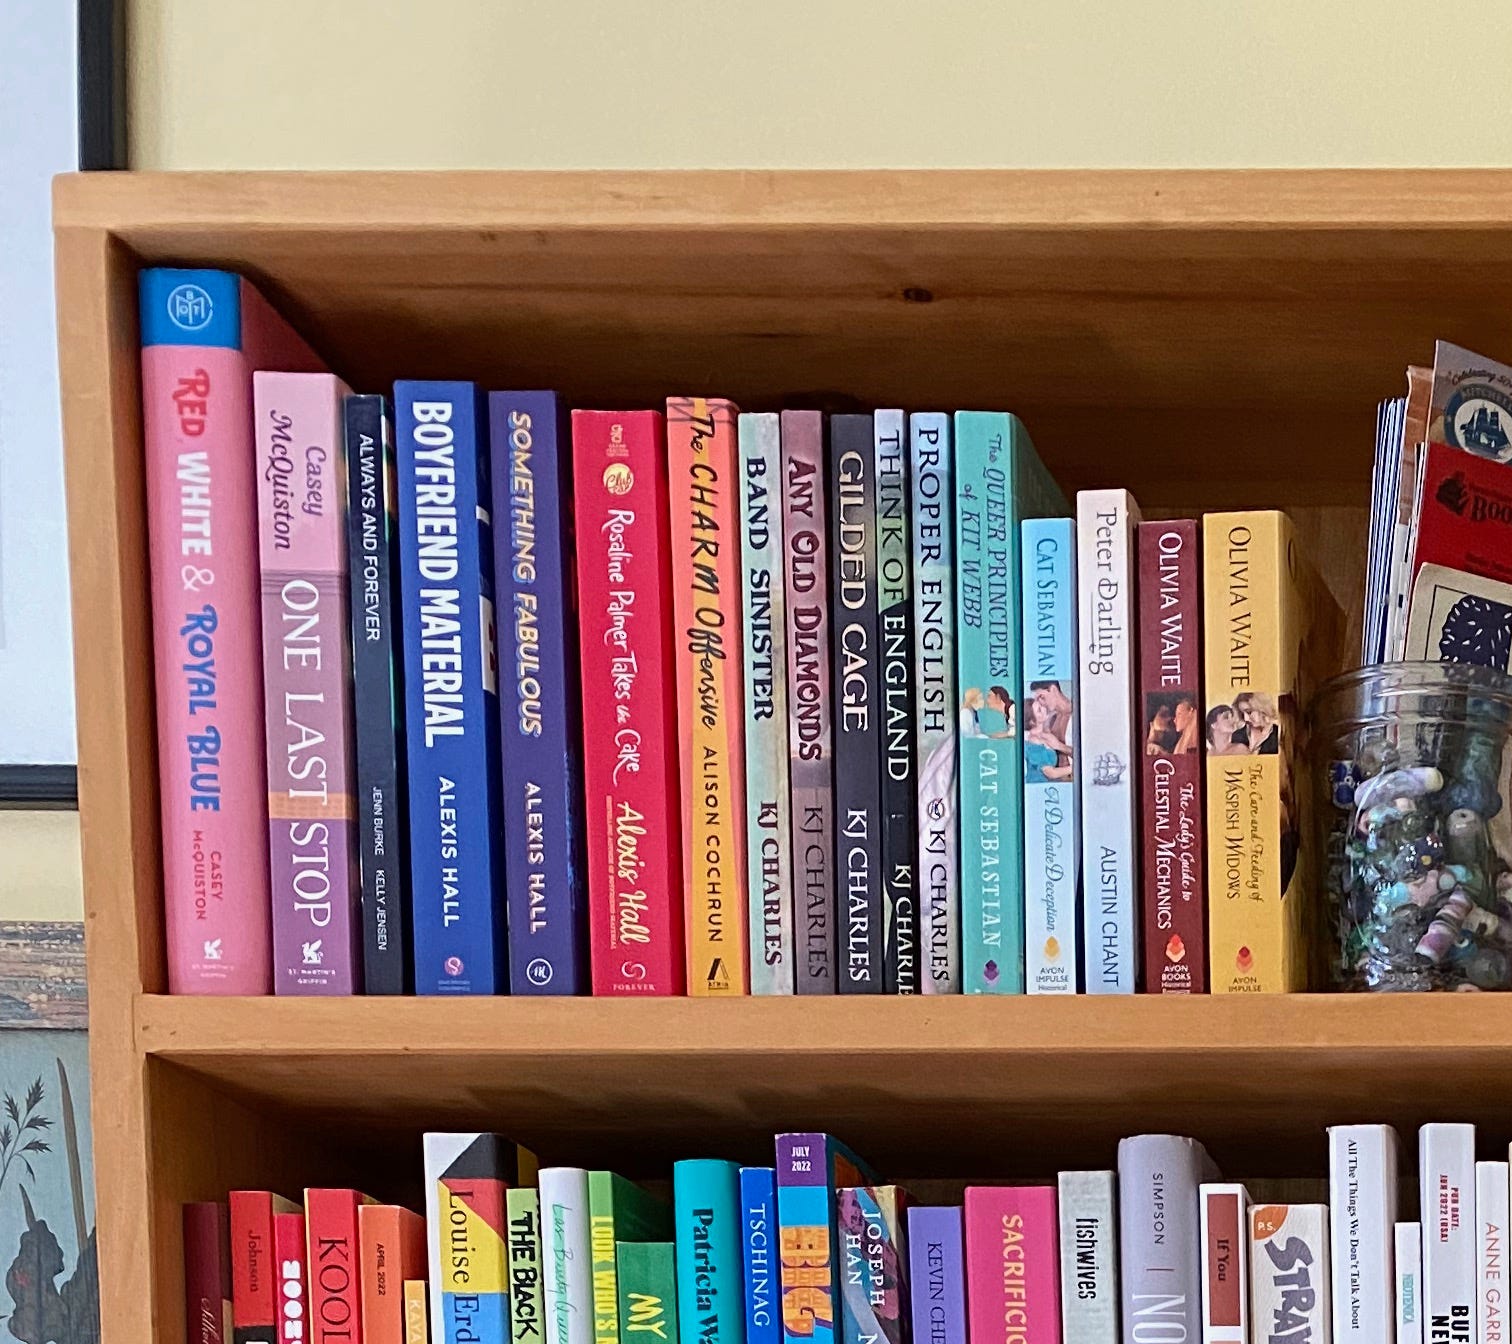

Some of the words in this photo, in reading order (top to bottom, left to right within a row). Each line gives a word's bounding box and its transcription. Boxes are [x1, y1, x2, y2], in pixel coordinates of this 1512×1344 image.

[176, 451, 212, 556] WHITE
[359, 434, 375, 517] ALWAYS
[413, 401, 459, 581] BOYFRIEND
[510, 412, 536, 581] SOMETHING
[746, 456, 768, 550] BAND
[363, 522, 376, 550] AND
[838, 450, 868, 609] GILDED
[1096, 506, 1119, 582] Peter
[1158, 532, 1180, 608] OLIVIA
[181, 565, 215, 592] &
[363, 555, 380, 641] FOREVER
[185, 604, 218, 715] ROYAL
[280, 579, 321, 670] ONE
[513, 590, 542, 737] FABULOUS
[749, 568, 774, 721] SINISTER
[1095, 576, 1120, 675] Darling
[1158, 615, 1182, 686] WAITE
[419, 589, 466, 747] MATERIAL
[841, 624, 868, 732] CAGE
[187, 726, 221, 812] BLUE
[285, 692, 325, 806] LAST
[704, 746, 720, 826] ALISON
[192, 830, 207, 920] McQUISTON
[210, 851, 222, 901] CASEY
[289, 822, 331, 927] STOP
[706, 833, 722, 942] COCHRUN
[1100, 846, 1116, 905] AUSTIN
[1102, 912, 1119, 986] CHANT
[1161, 972, 1191, 981] BOOKS
[1164, 965, 1188, 973] AVON
[791, 1146, 810, 1159] JULY
[791, 1161, 810, 1171] 2022
[447, 1190, 471, 1284] Louise
[1152, 1173, 1164, 1245] SIMPSON
[377, 1243, 386, 1266] APRIL
[377, 1267, 386, 1295] 2022
[692, 1207, 715, 1309] Patricia
[1075, 1217, 1097, 1301] fishwives
[626, 1293, 662, 1339] MY
